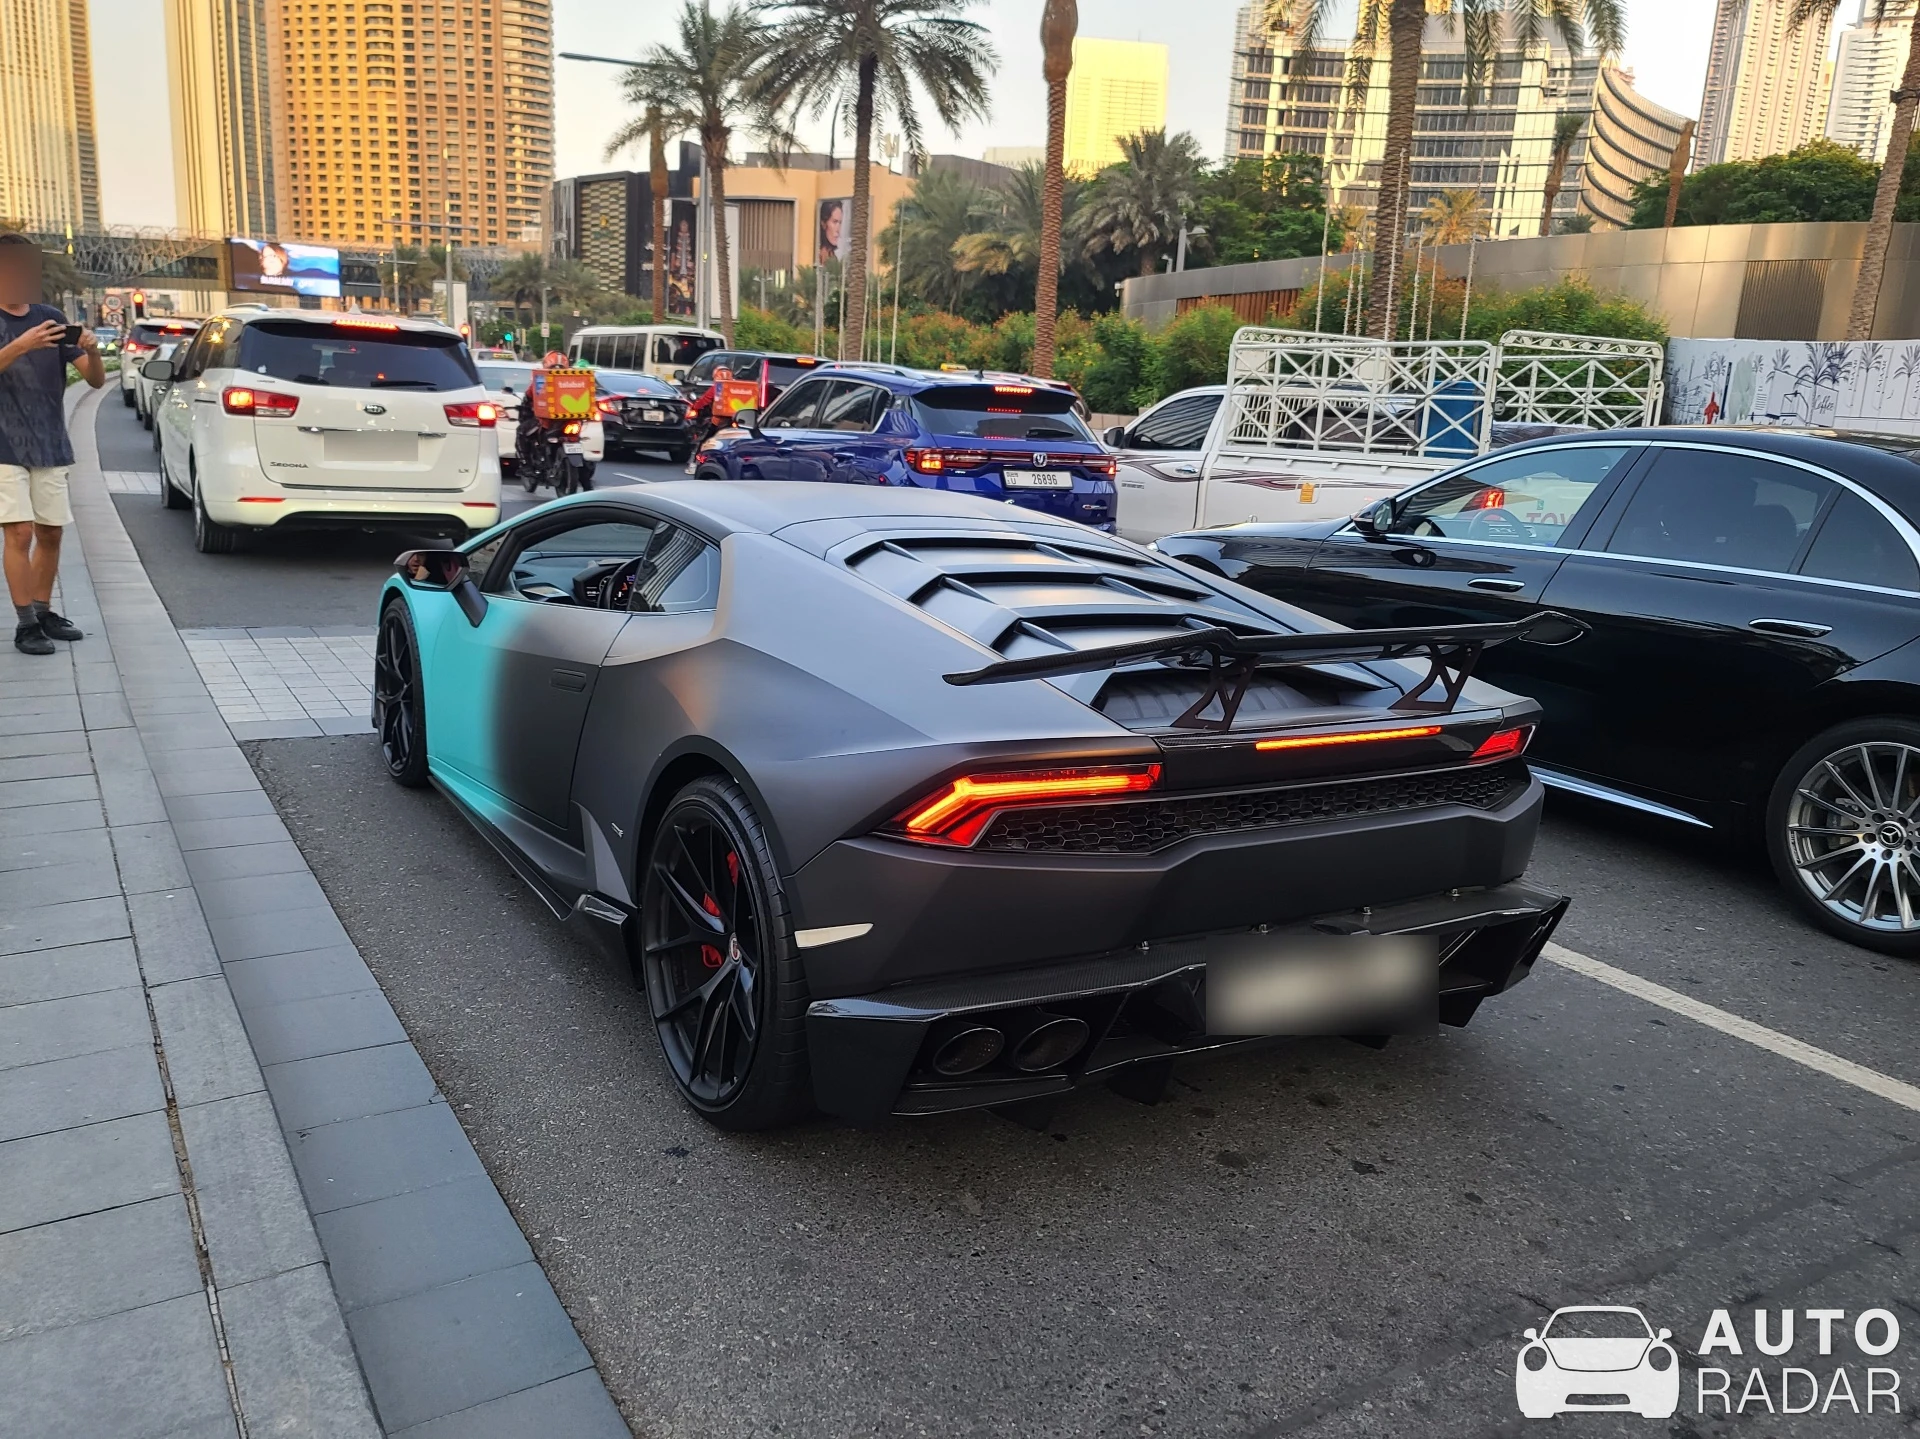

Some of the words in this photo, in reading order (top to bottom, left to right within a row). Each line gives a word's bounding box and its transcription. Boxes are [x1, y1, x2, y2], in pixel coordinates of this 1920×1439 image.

[558, 381, 585, 389] talabat
[270, 461, 309, 469] SEDONA
[1032, 474, 1058, 485] 26896
